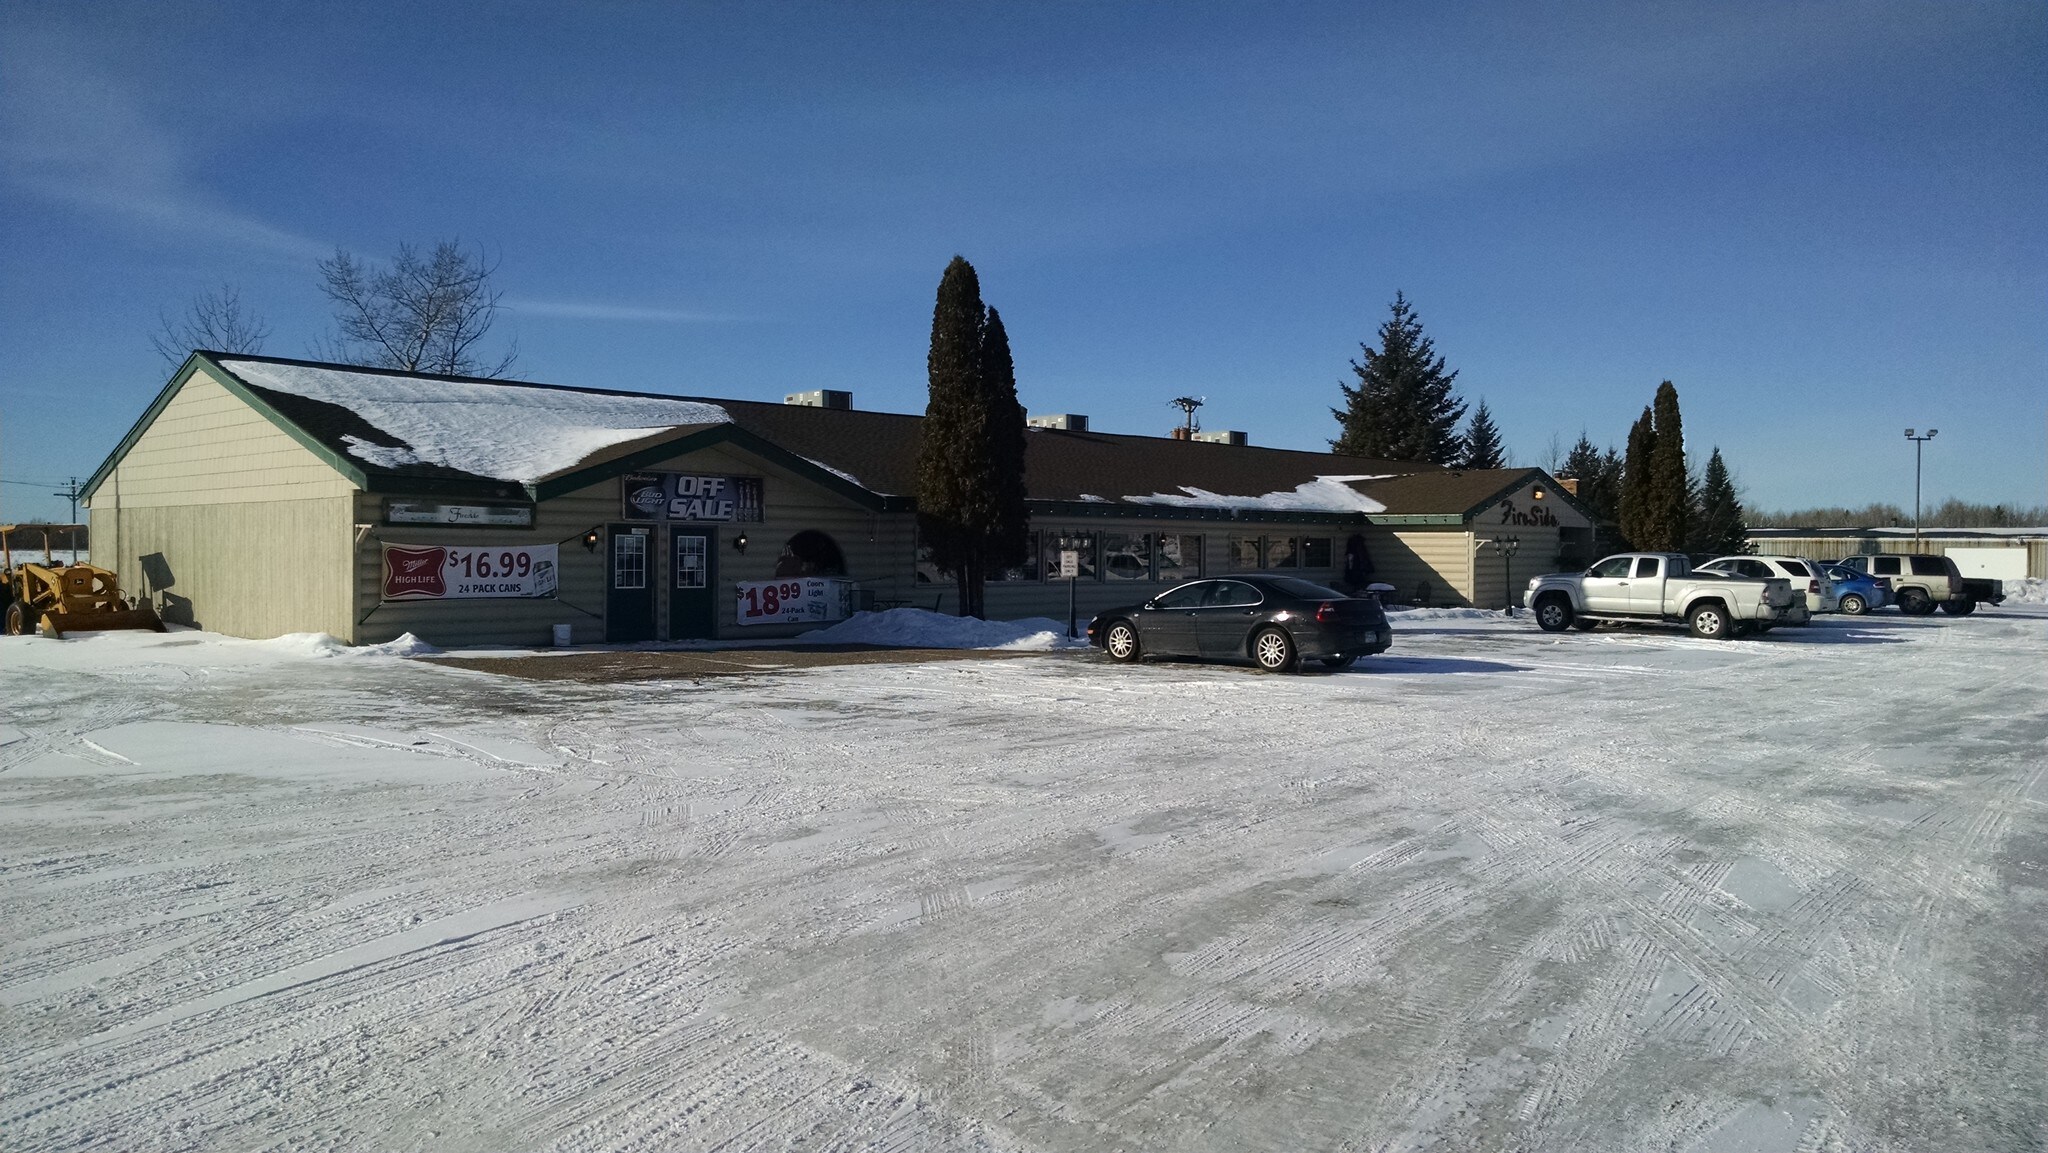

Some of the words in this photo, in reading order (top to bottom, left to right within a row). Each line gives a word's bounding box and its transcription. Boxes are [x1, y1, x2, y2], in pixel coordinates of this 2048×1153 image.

[678, 476, 725, 497] OFF
[669, 498, 733, 519] SALE
[449, 550, 532, 579] $16.99
[395, 575, 417, 584] HIGH
[418, 575, 435, 584] LIFE
[806, 580, 825, 588] Coors
[458, 584, 470, 594] 24
[473, 584, 496, 594] PACK
[498, 583, 522, 593] CANS
